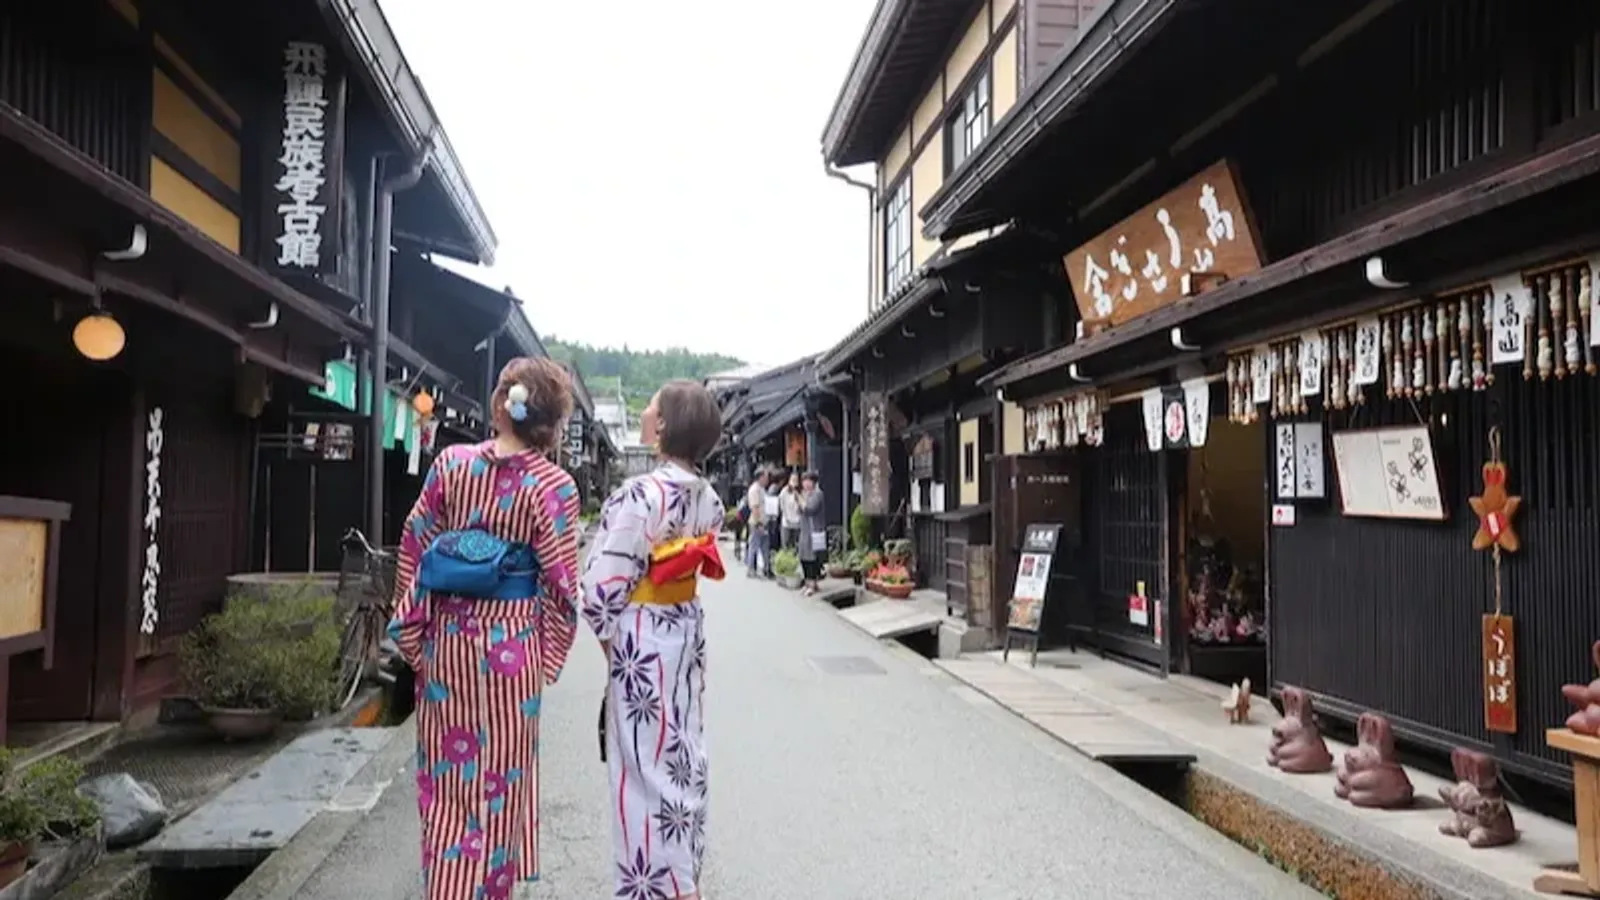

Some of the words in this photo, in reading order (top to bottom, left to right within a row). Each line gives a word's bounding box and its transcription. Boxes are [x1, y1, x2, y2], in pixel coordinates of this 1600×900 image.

[275, 41, 327, 267] 飛騨民族考古館
[1499, 293, 1519, 353] 高山
